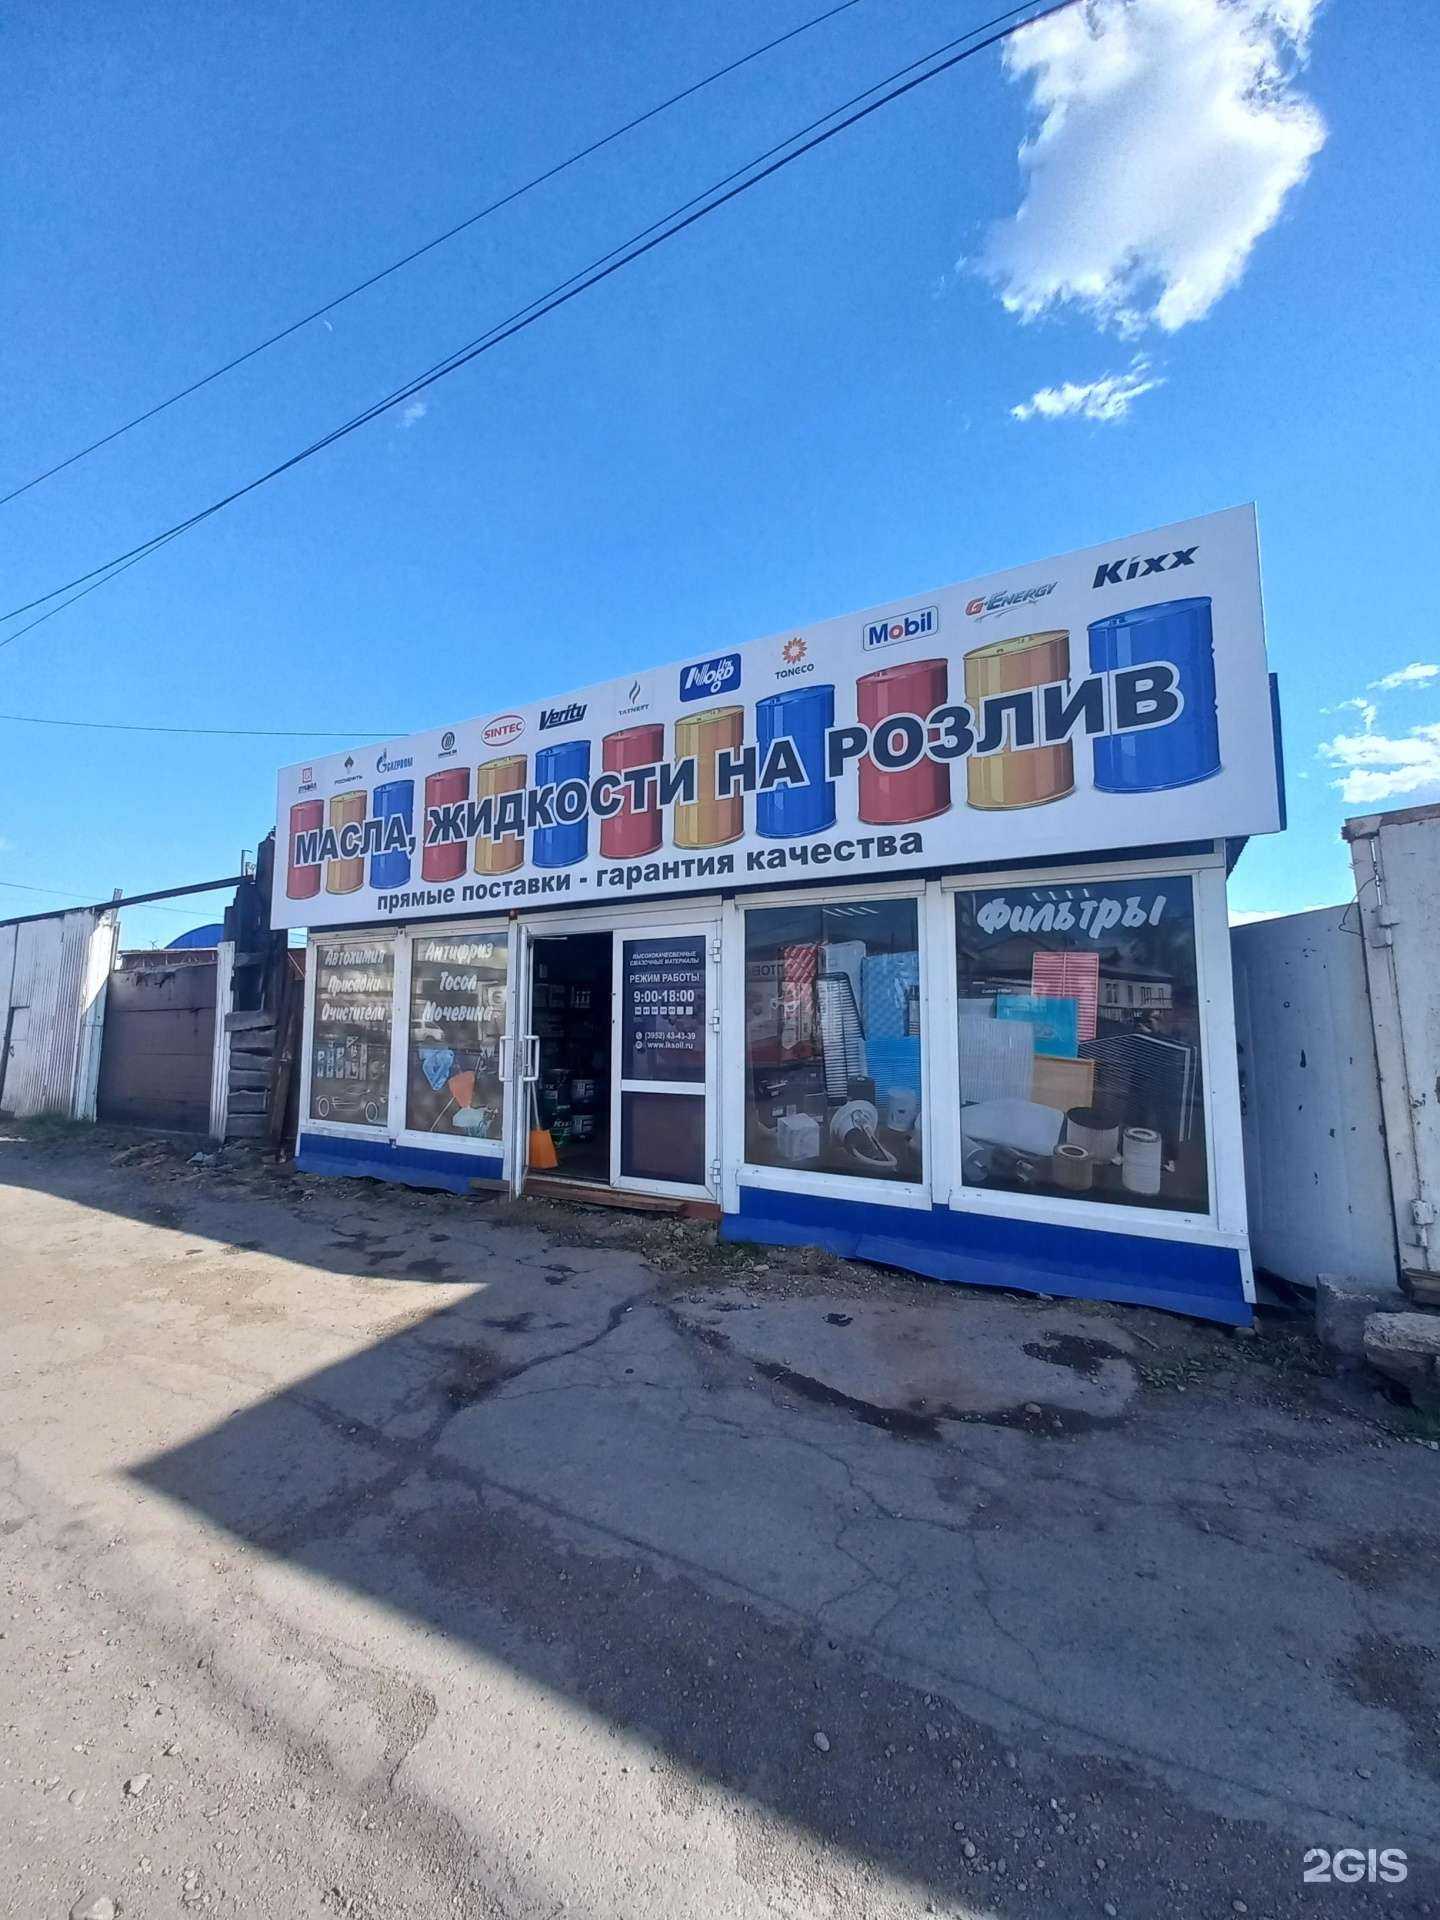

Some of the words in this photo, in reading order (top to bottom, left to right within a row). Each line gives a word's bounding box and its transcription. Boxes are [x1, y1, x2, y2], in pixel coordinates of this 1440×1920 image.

[1093, 545, 1200, 588] Kixx
[868, 612, 932, 645] Mobil
[539, 703, 588, 731] Verity
[484, 722, 523, 740] SINTEC
[296, 817, 415, 865] МАСЛА,
[428, 758, 696, 843] ЖИДКОСТИ
[720, 742, 805, 794] НА
[829, 666, 1178, 777] РОЗЛИВ
[378, 886, 455, 913] прямые
[462, 872, 571, 902] поставки
[598, 854, 734, 888] гарантия
[747, 832, 922, 872] качества
[977, 896, 1166, 939] Фильтры
[425, 942, 493, 966] Антифриз
[439, 971, 478, 991] Тосол
[630, 974, 660, 983] РЕЖИМ
[662, 973, 700, 982] РАБОТЫ
[633, 990, 695, 1002] 9:00-18:00
[322, 1002, 386, 1021] Очистители
[422, 1001, 494, 1021] Мочевина
